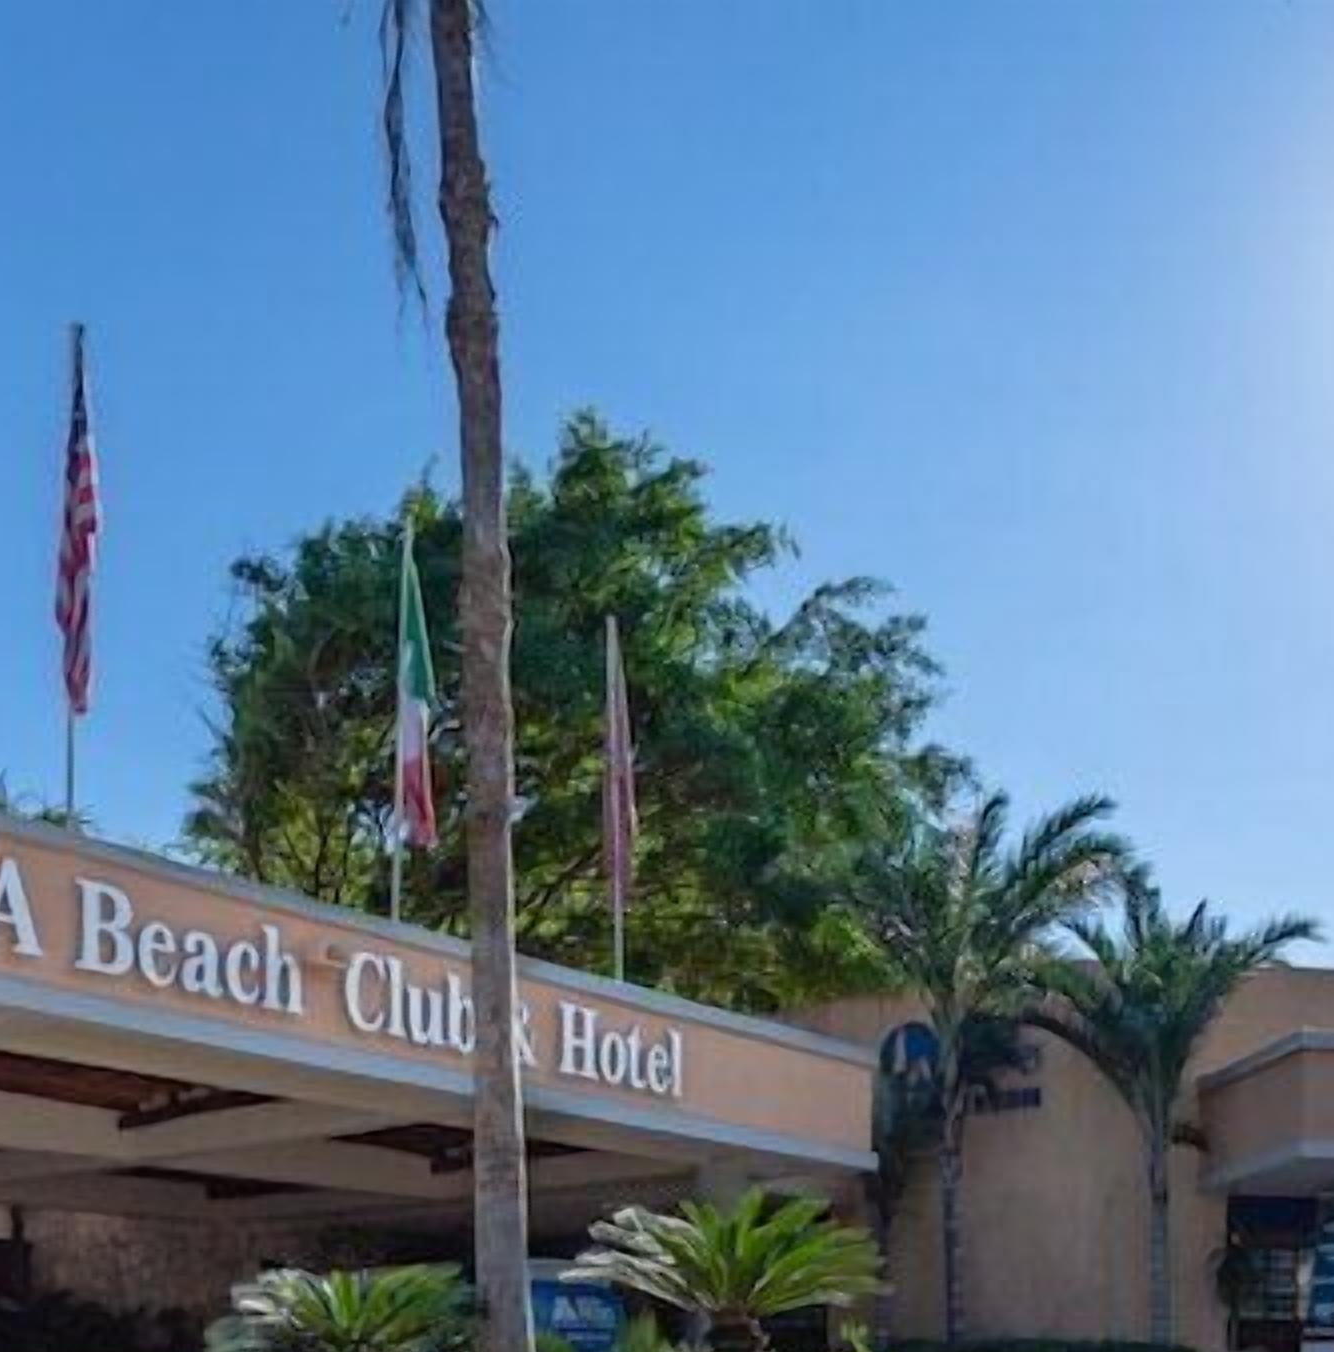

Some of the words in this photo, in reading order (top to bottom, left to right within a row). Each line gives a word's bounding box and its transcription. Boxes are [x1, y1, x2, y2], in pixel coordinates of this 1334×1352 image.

[75, 876, 303, 1016] Beach
[345, 952, 477, 1054] Club
[559, 1000, 684, 1097] Hotel
